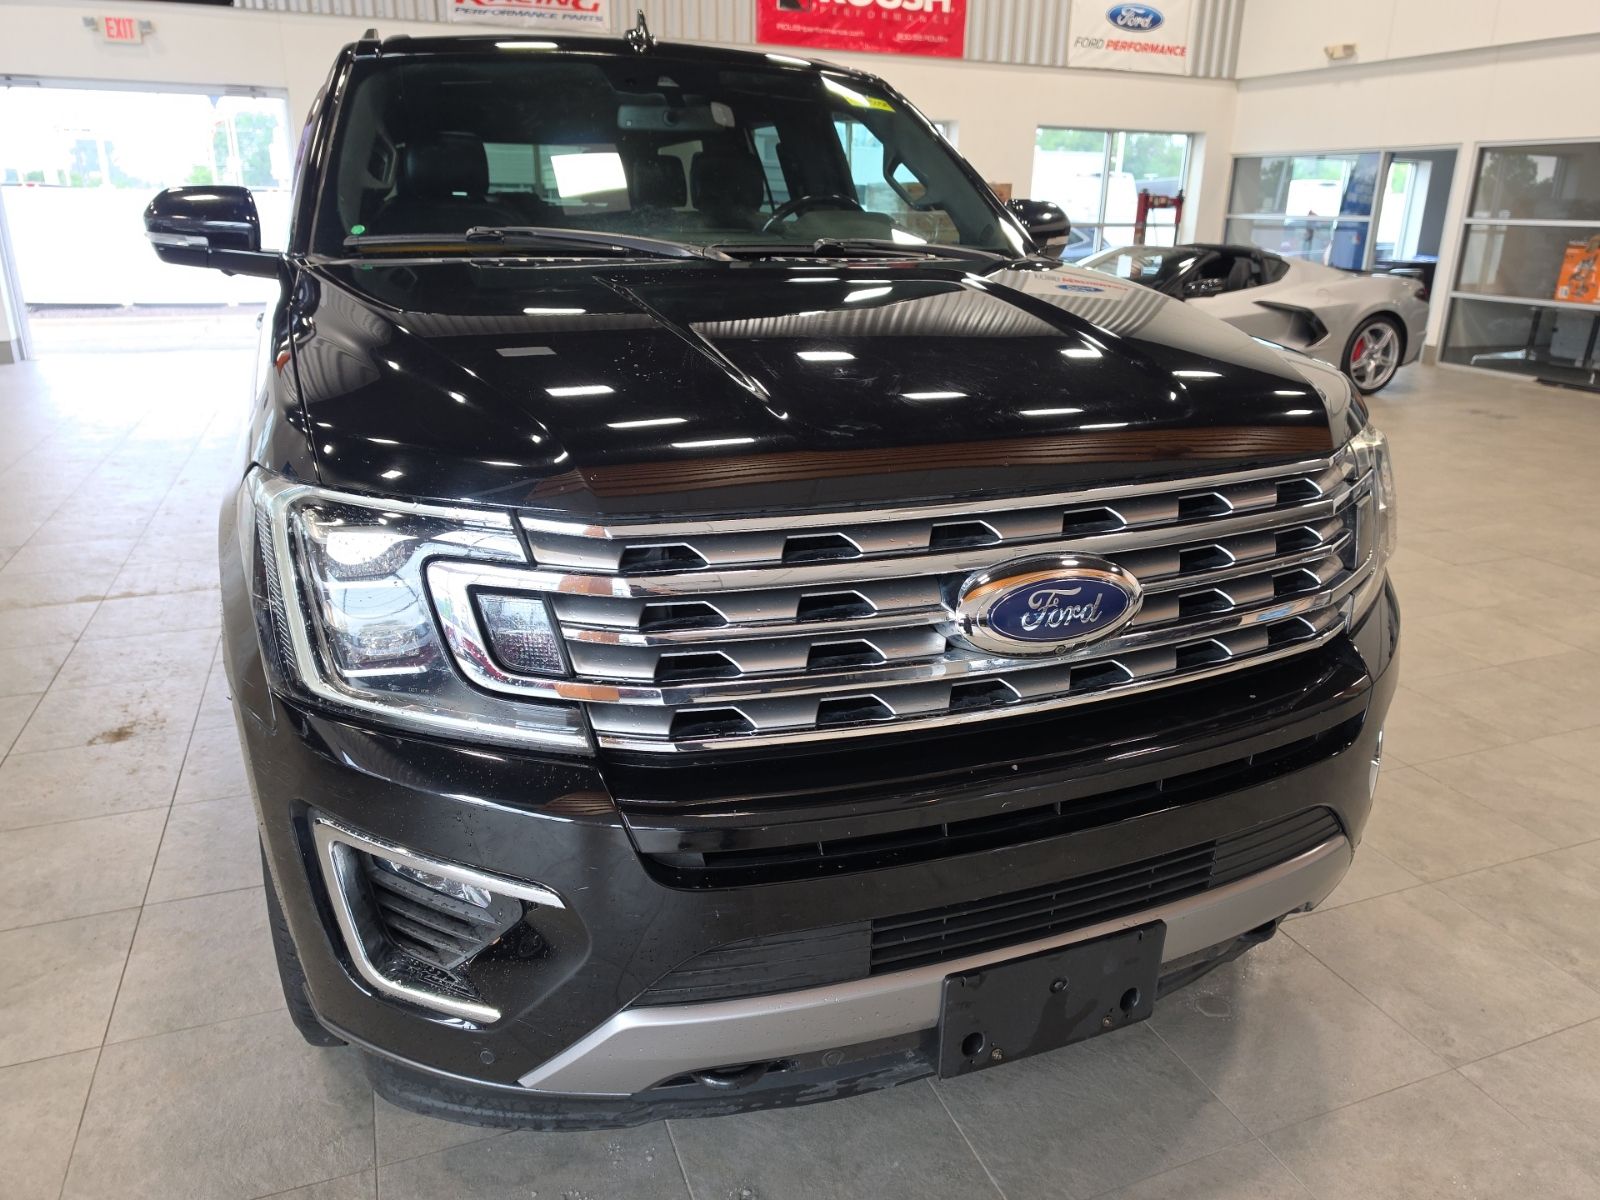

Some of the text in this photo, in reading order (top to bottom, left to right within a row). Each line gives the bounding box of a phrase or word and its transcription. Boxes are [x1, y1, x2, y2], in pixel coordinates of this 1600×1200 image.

[455, 8, 604, 22] PERFORMANCE PARTS
[1116, 7, 1154, 28] Ford
[104, 16, 135, 39] EXIT
[1074, 37, 1187, 57] FORD PERFORMANCE
[1021, 586, 1103, 631] Ford
